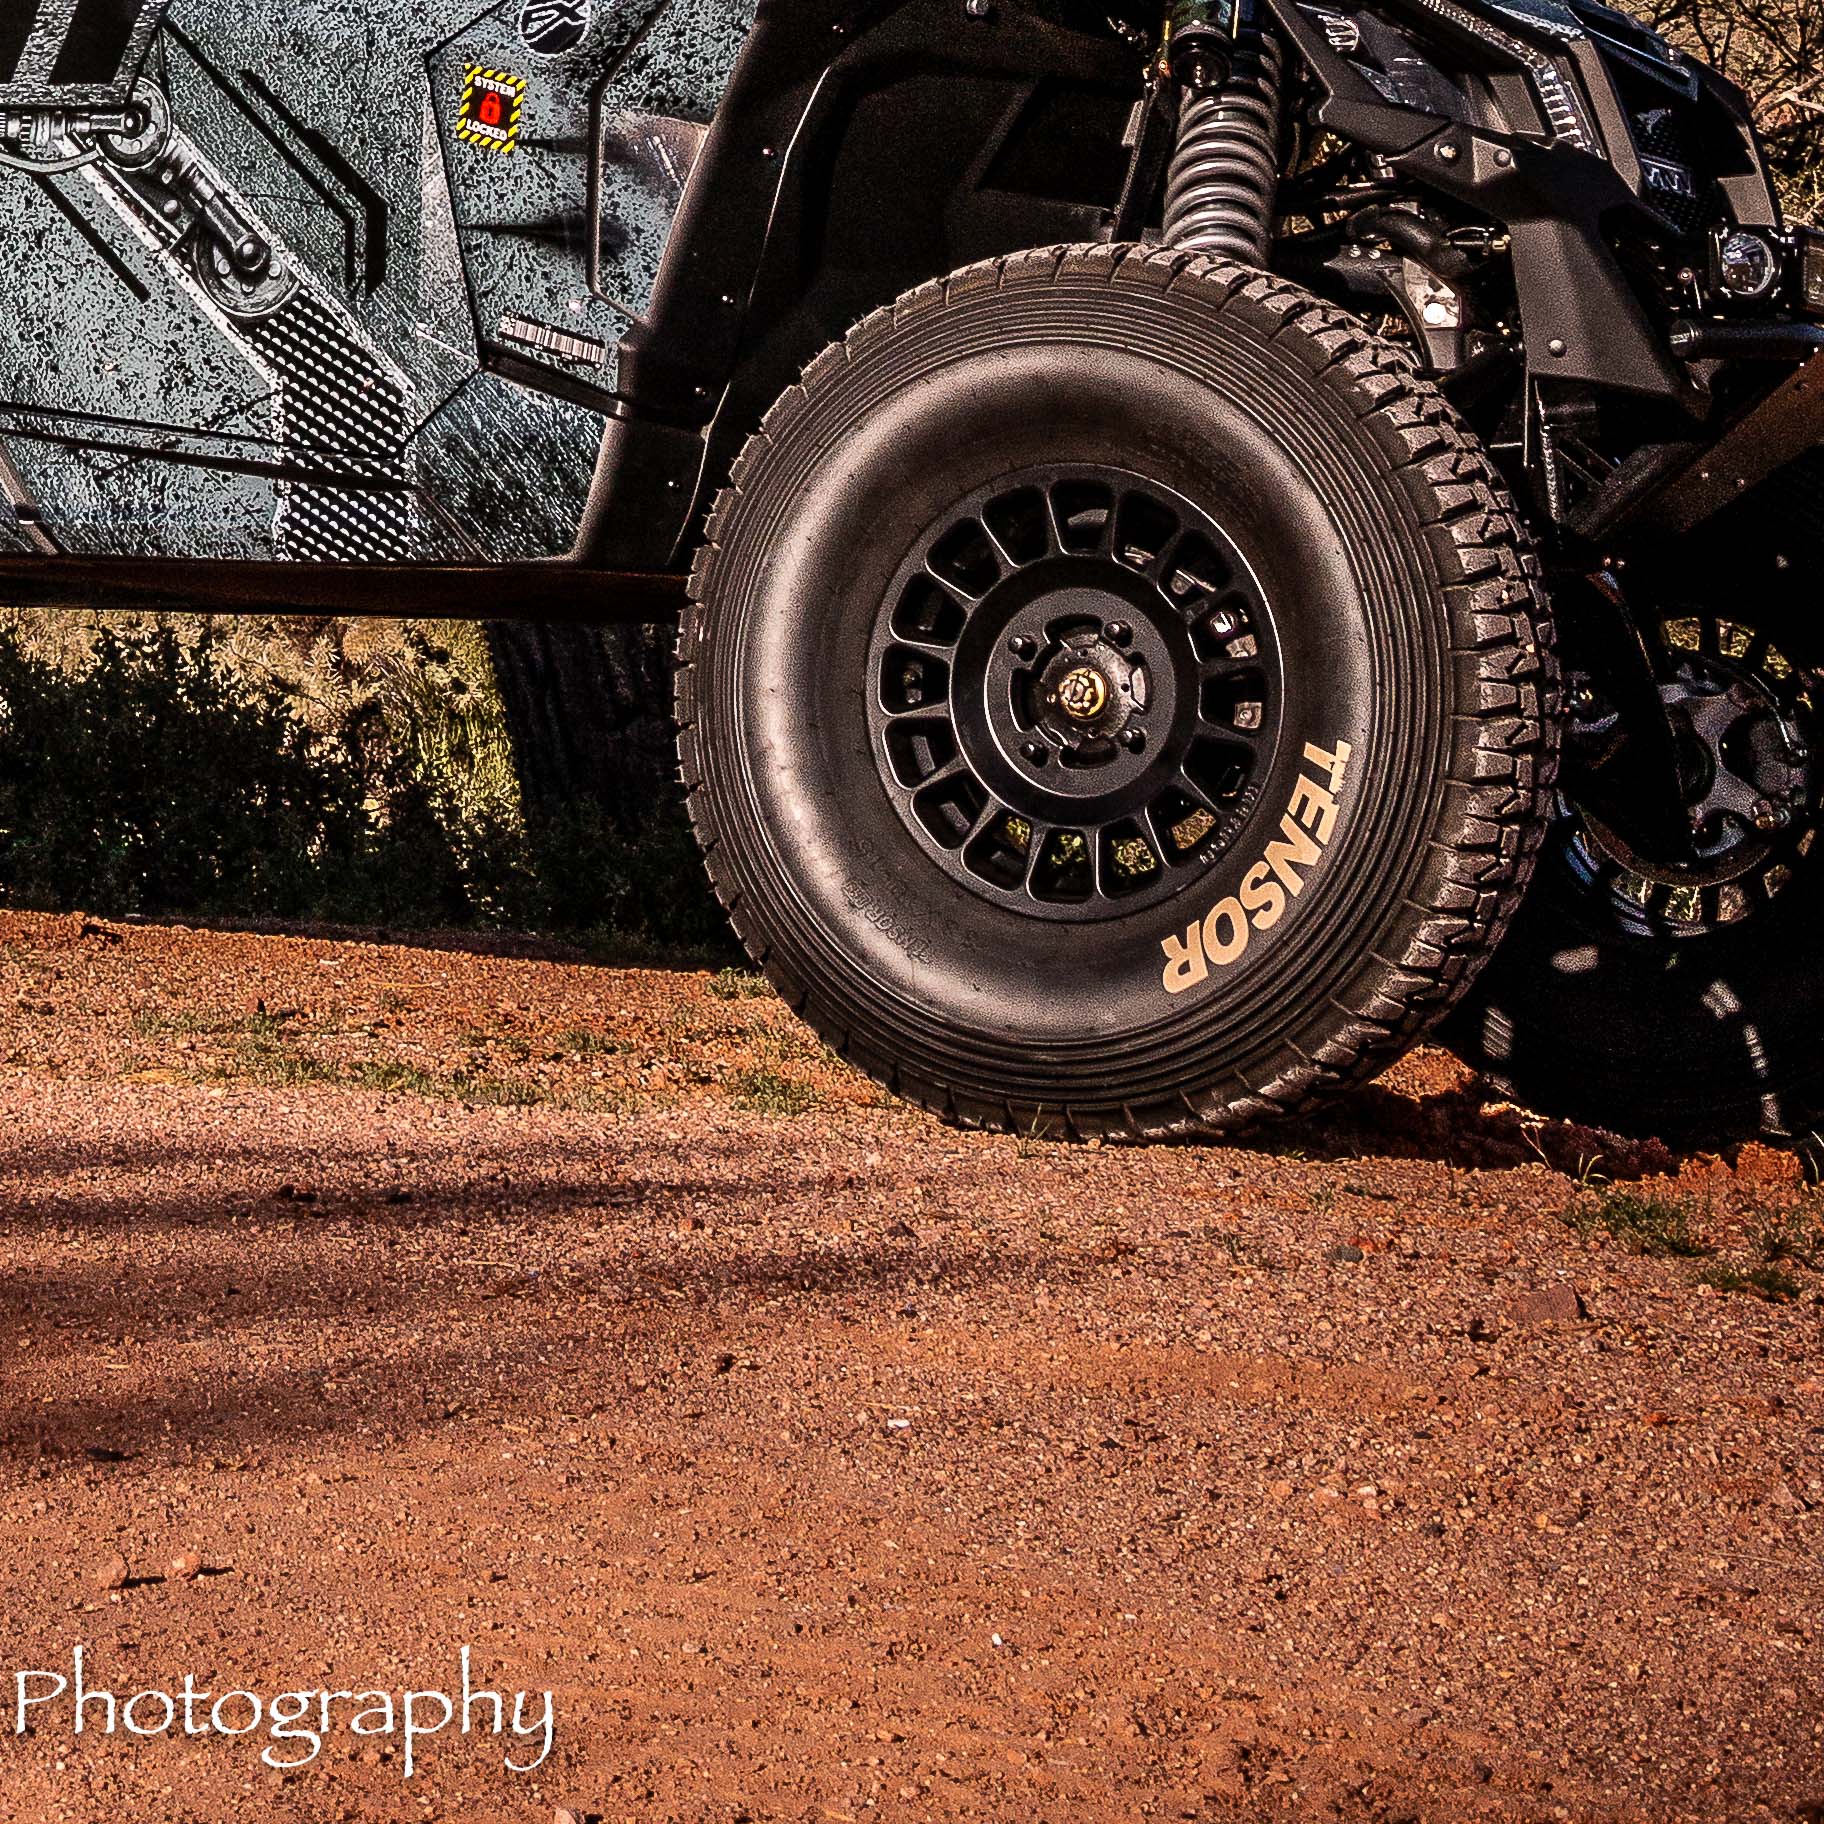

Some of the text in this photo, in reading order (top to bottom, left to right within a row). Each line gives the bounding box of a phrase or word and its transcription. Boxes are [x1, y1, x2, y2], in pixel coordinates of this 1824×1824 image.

[473, 75, 516, 98] SYSTEM
[465, 118, 508, 141] LOCKED
[1160, 739, 1353, 994] TENSOR
